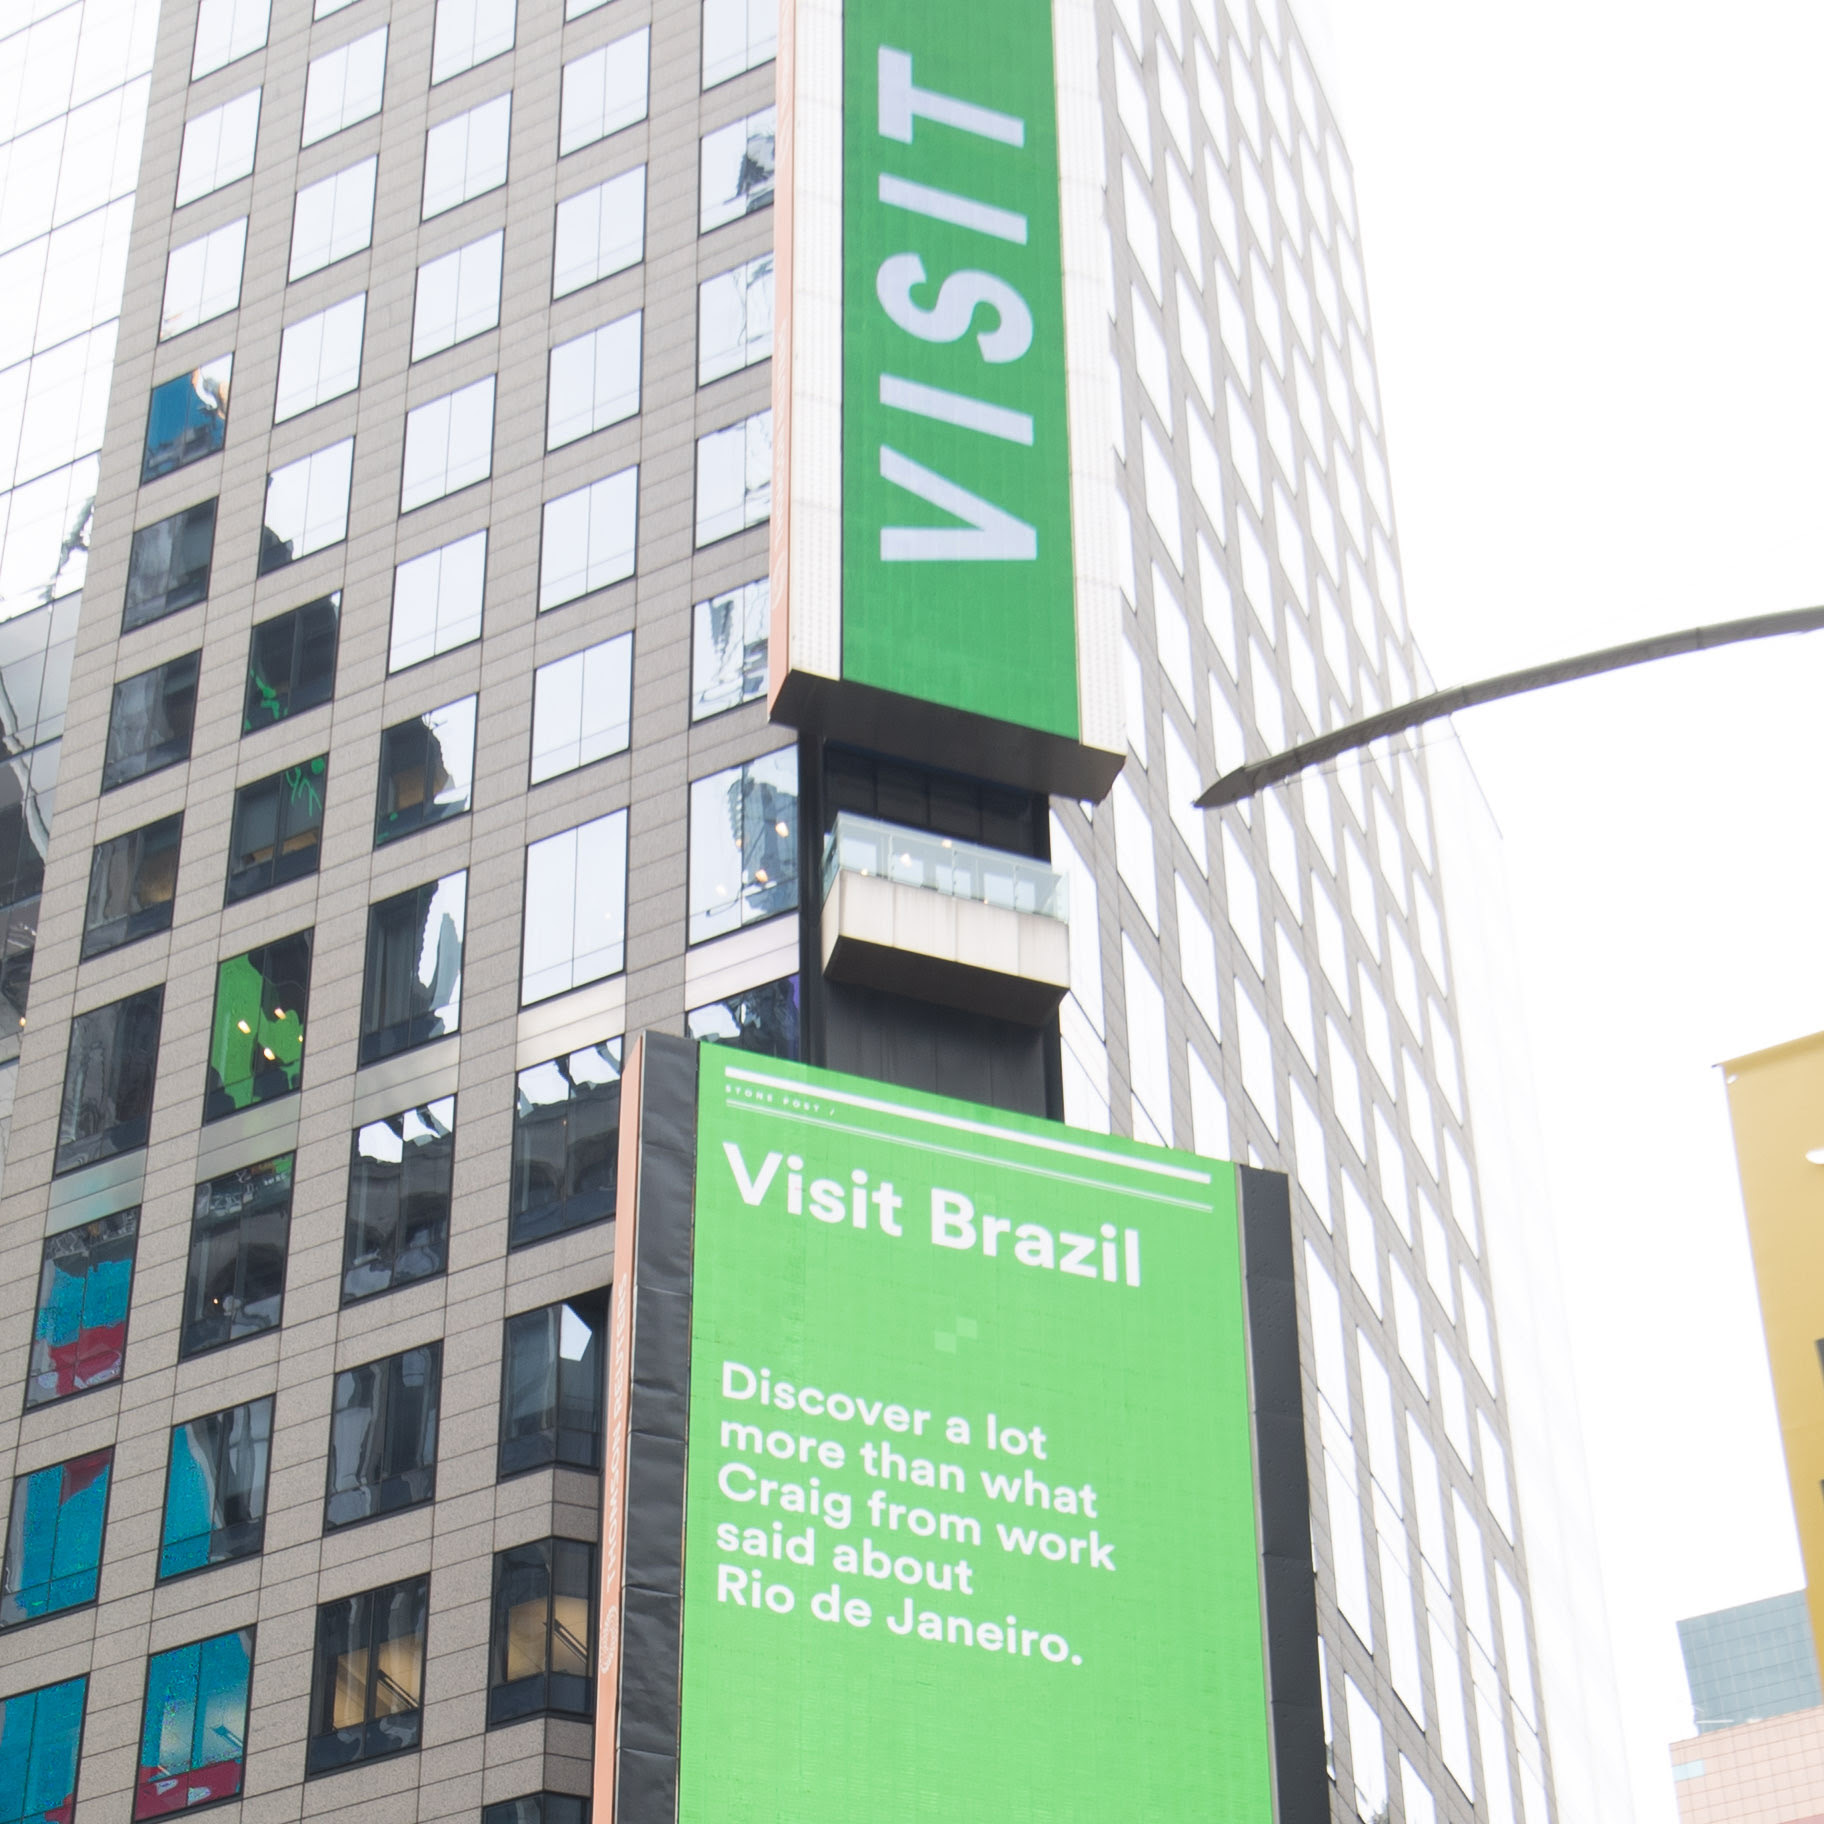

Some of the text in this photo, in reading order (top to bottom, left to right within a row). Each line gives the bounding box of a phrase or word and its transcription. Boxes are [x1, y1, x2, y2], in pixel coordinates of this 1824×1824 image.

[875, 44, 1038, 562] VISIT
[722, 1141, 1141, 1287] Visit Brazil
[721, 1360, 1047, 1460] Discover a lot
[717, 1462, 1117, 1571] Craig from work
[720, 1420, 1098, 1519] more than what
[716, 1521, 974, 1595] said about
[717, 1563, 1083, 1666] Rio de Janeiro.
